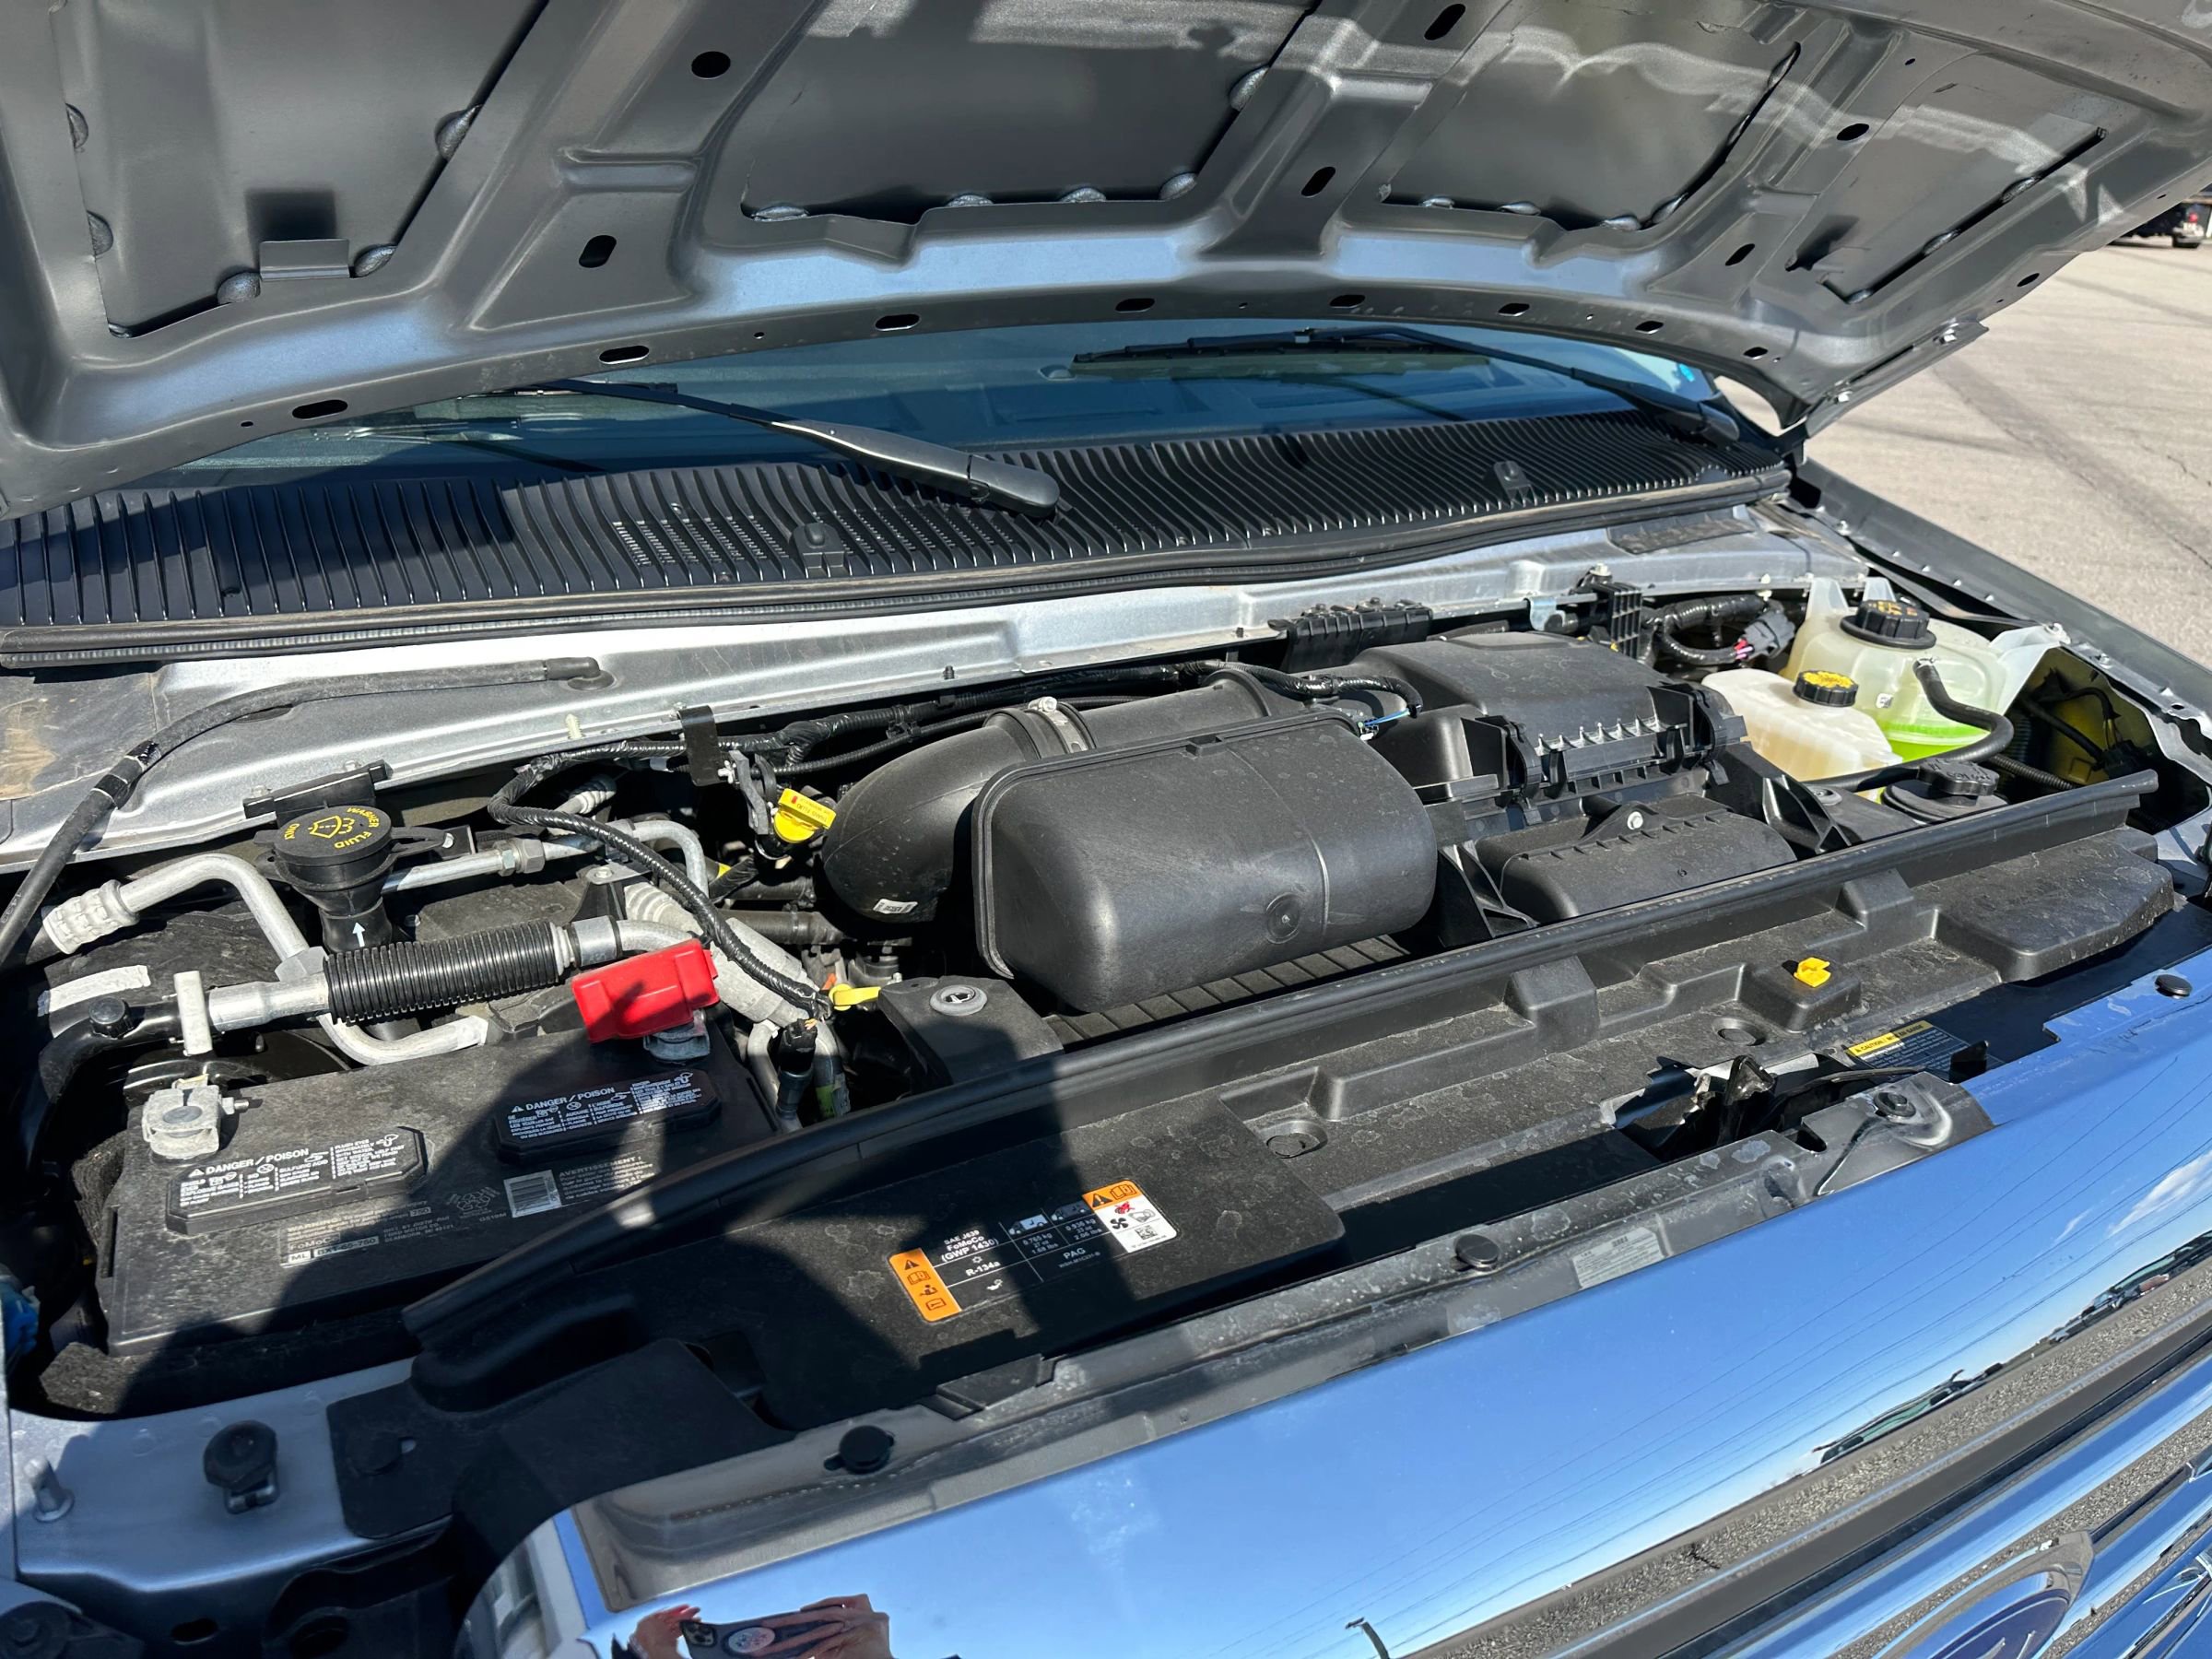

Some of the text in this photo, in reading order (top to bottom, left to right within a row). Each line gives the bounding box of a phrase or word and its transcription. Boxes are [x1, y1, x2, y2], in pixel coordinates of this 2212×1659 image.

[284, 807, 379, 849] WASHER FLUID ONLY
[944, 1230, 980, 1245] SAE J639
[947, 1235, 984, 1252] FoMoCo
[317, 1238, 377, 1255] BXT-65-750
[940, 1238, 999, 1263] (GWP 1430)
[1063, 1247, 1086, 1259] PAG
[965, 1261, 1001, 1277] R-134a
